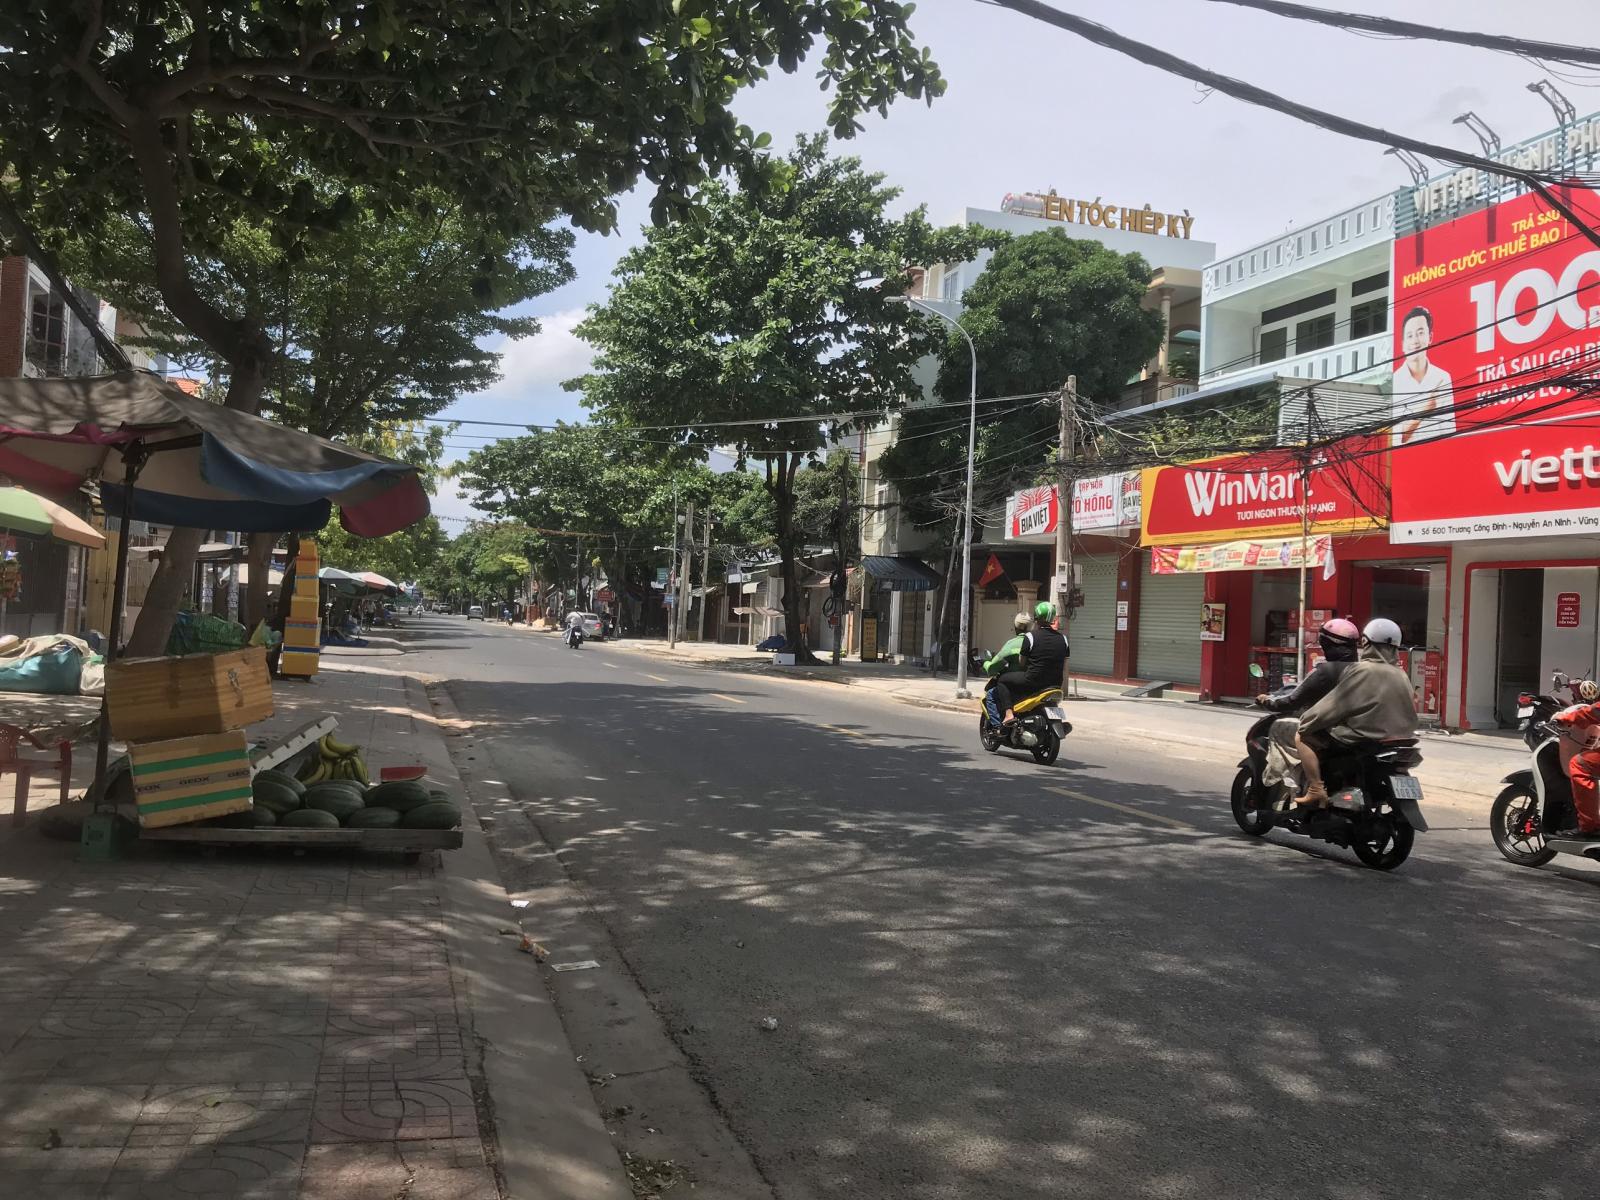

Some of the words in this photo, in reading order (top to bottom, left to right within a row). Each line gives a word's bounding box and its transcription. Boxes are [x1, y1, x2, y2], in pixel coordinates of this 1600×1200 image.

[1414, 166, 1480, 213] VIETTEL
[1077, 196, 1117, 229] TÓC
[1167, 209, 1195, 240] KỲ
[1511, 213, 1535, 234] TRẢ
[1537, 209, 1561, 226] SAU
[1402, 263, 1447, 289] KHÔNG
[1448, 250, 1487, 273] CƯỚC
[1489, 234, 1528, 261] THUÊ
[1530, 227, 1561, 249] BAO
[1476, 356, 1507, 385] TRẢ
[1511, 352, 1545, 375] SAU
[1548, 345, 1581, 370] GỌI
[1072, 496, 1081, 514] Ô
[1255, 508, 1276, 519] NGON
[1021, 514, 1032, 533] BIA
[1033, 506, 1048, 528] VIỆT
[1432, 526, 1446, 535] 600
[1474, 523, 1490, 533] Công
[1492, 521, 1508, 532] Định
[1513, 518, 1541, 531] Nguyễn
[1542, 519, 1553, 528] An
[1555, 517, 1572, 527] Ninh
[1579, 516, 1599, 527] Vũng
[135, 783, 161, 793] EOX
[227, 768, 250, 778] GEO
